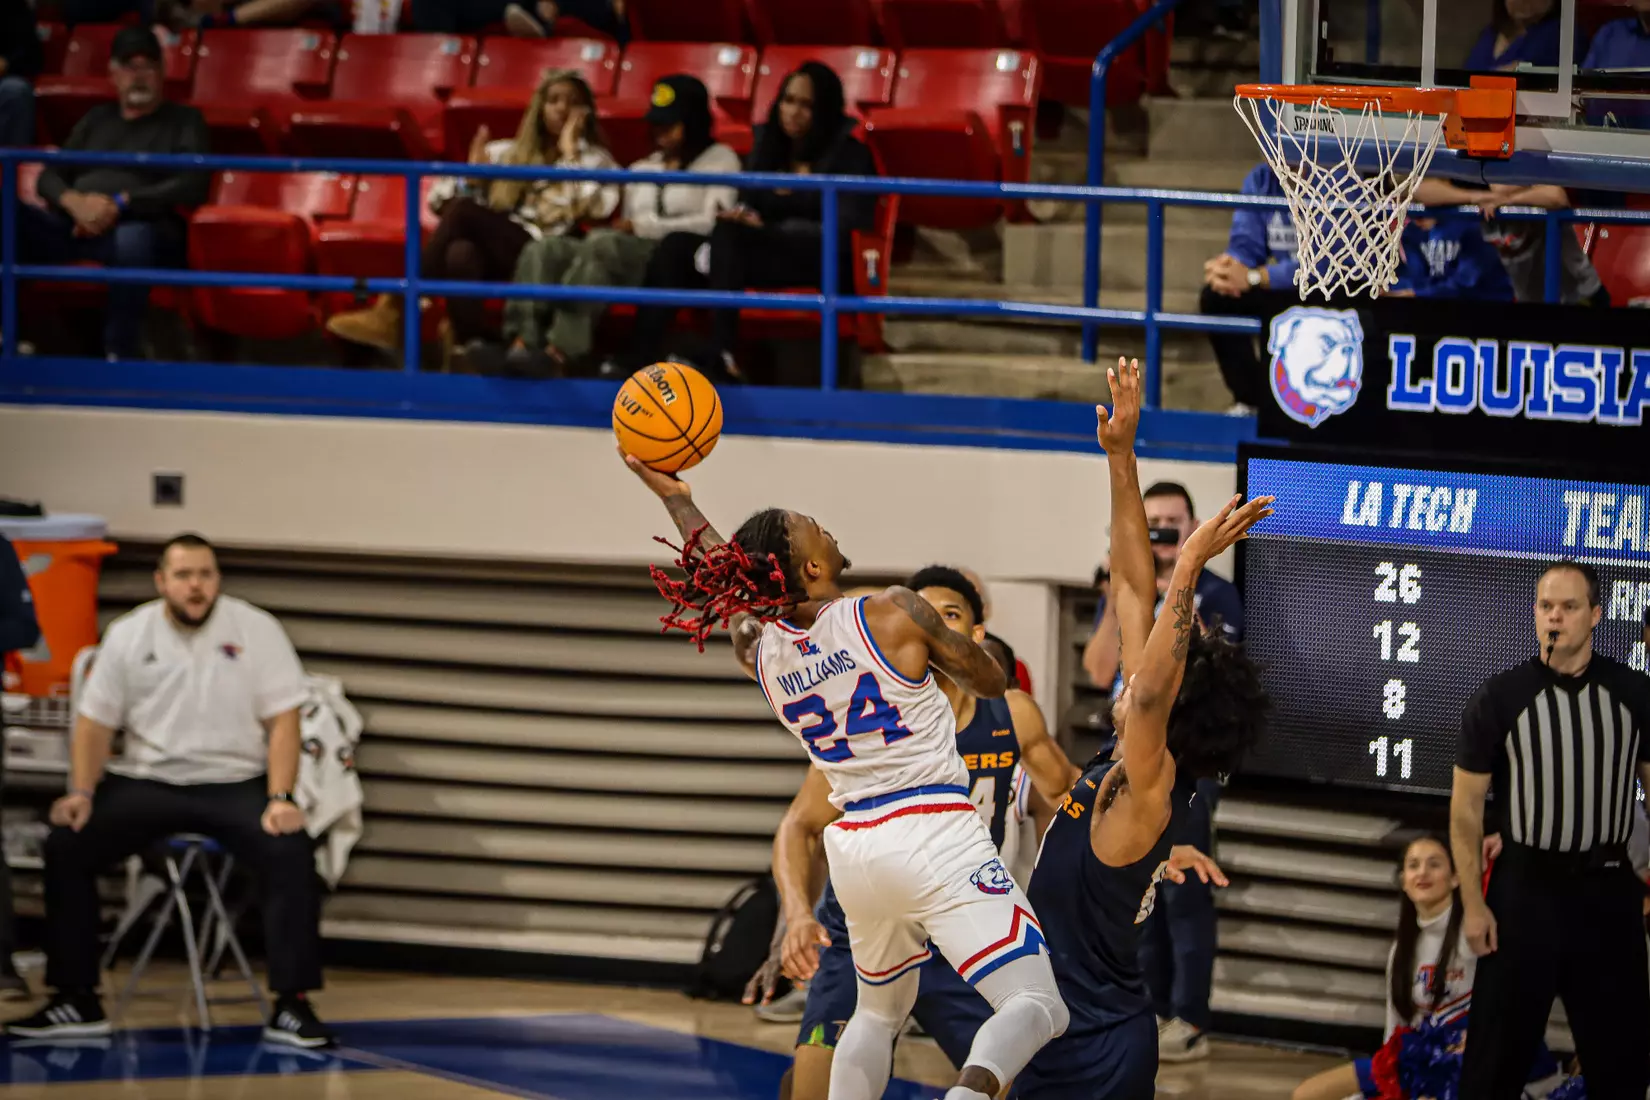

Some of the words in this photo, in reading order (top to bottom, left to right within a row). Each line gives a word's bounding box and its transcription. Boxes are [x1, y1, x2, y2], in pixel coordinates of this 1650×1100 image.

[1294, 115, 1335, 133] SPALDING
[1340, 480, 1382, 527] LA
[1388, 483, 1477, 534] TECH
[1562, 490, 1650, 553] TEA
[1374, 561, 1421, 604] 26
[1373, 619, 1420, 663] 12
[776, 648, 857, 697] WILLIAMS
[782, 671, 914, 763] 24
[1383, 678, 1406, 720] 8
[1368, 735, 1412, 779] 11
